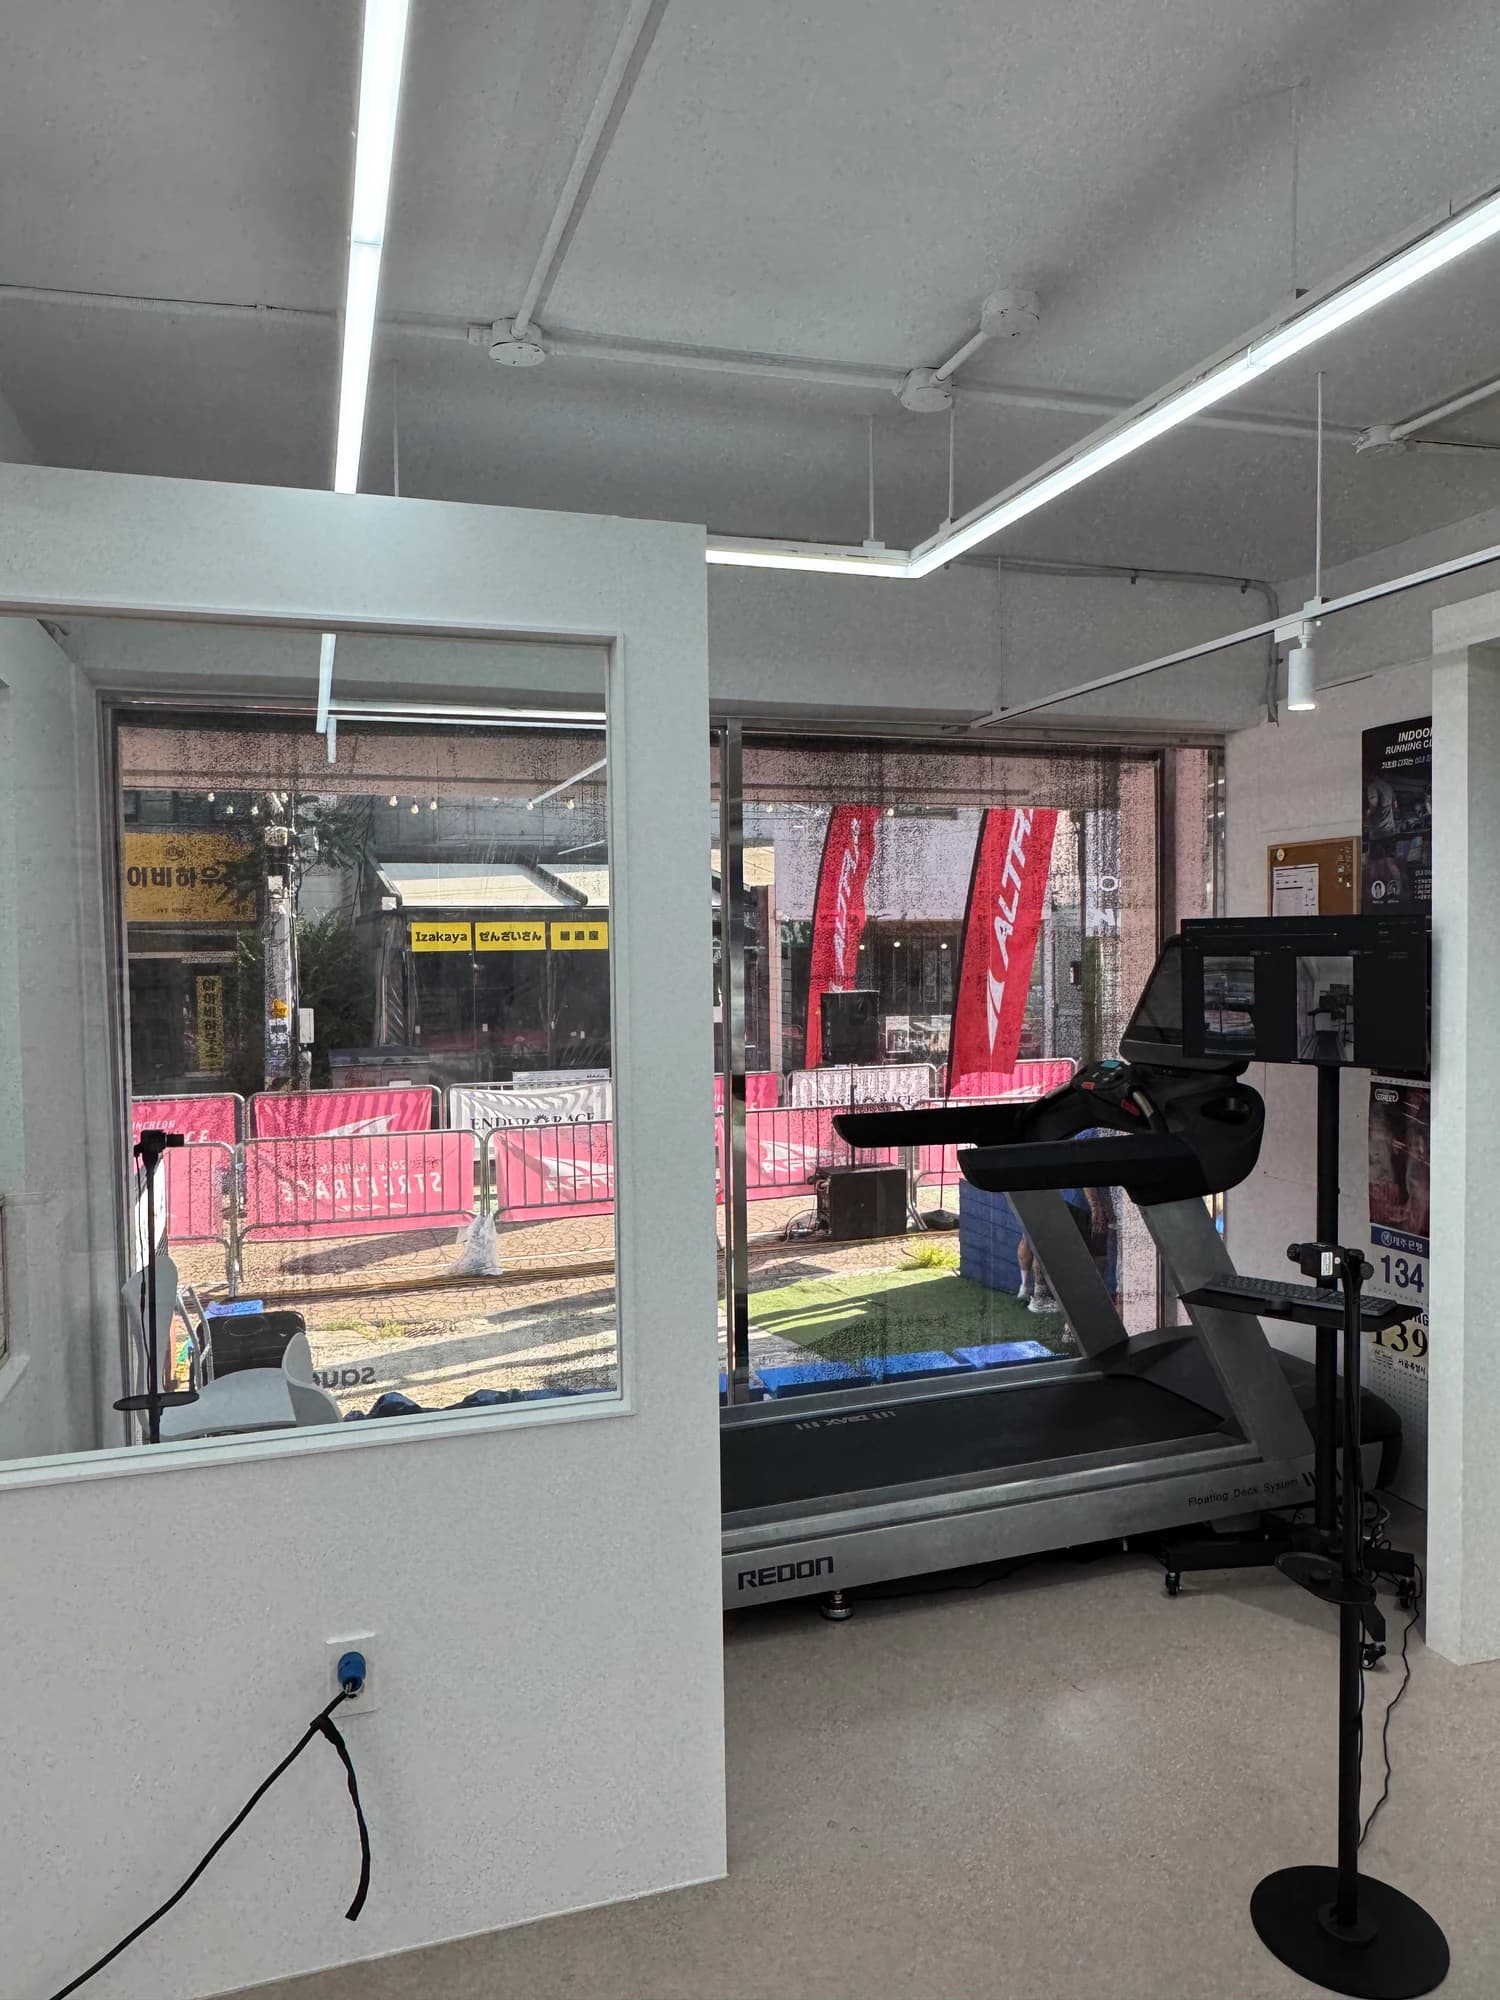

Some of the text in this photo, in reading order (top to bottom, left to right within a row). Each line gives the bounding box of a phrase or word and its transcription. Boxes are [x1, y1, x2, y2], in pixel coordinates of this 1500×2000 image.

[1385, 740, 1422, 755] RUNNING
[1398, 727, 1432, 742] INDOO
[994, 808, 1034, 972] ALTR
[415, 931, 468, 944] Izakaya
[132, 1119, 175, 1130] INCHEON
[1380, 1254, 1425, 1293] 134
[1372, 1322, 1428, 1358] 139
[1188, 1479, 1299, 1507] Floating Deck System
[738, 1556, 834, 1591] REDON
